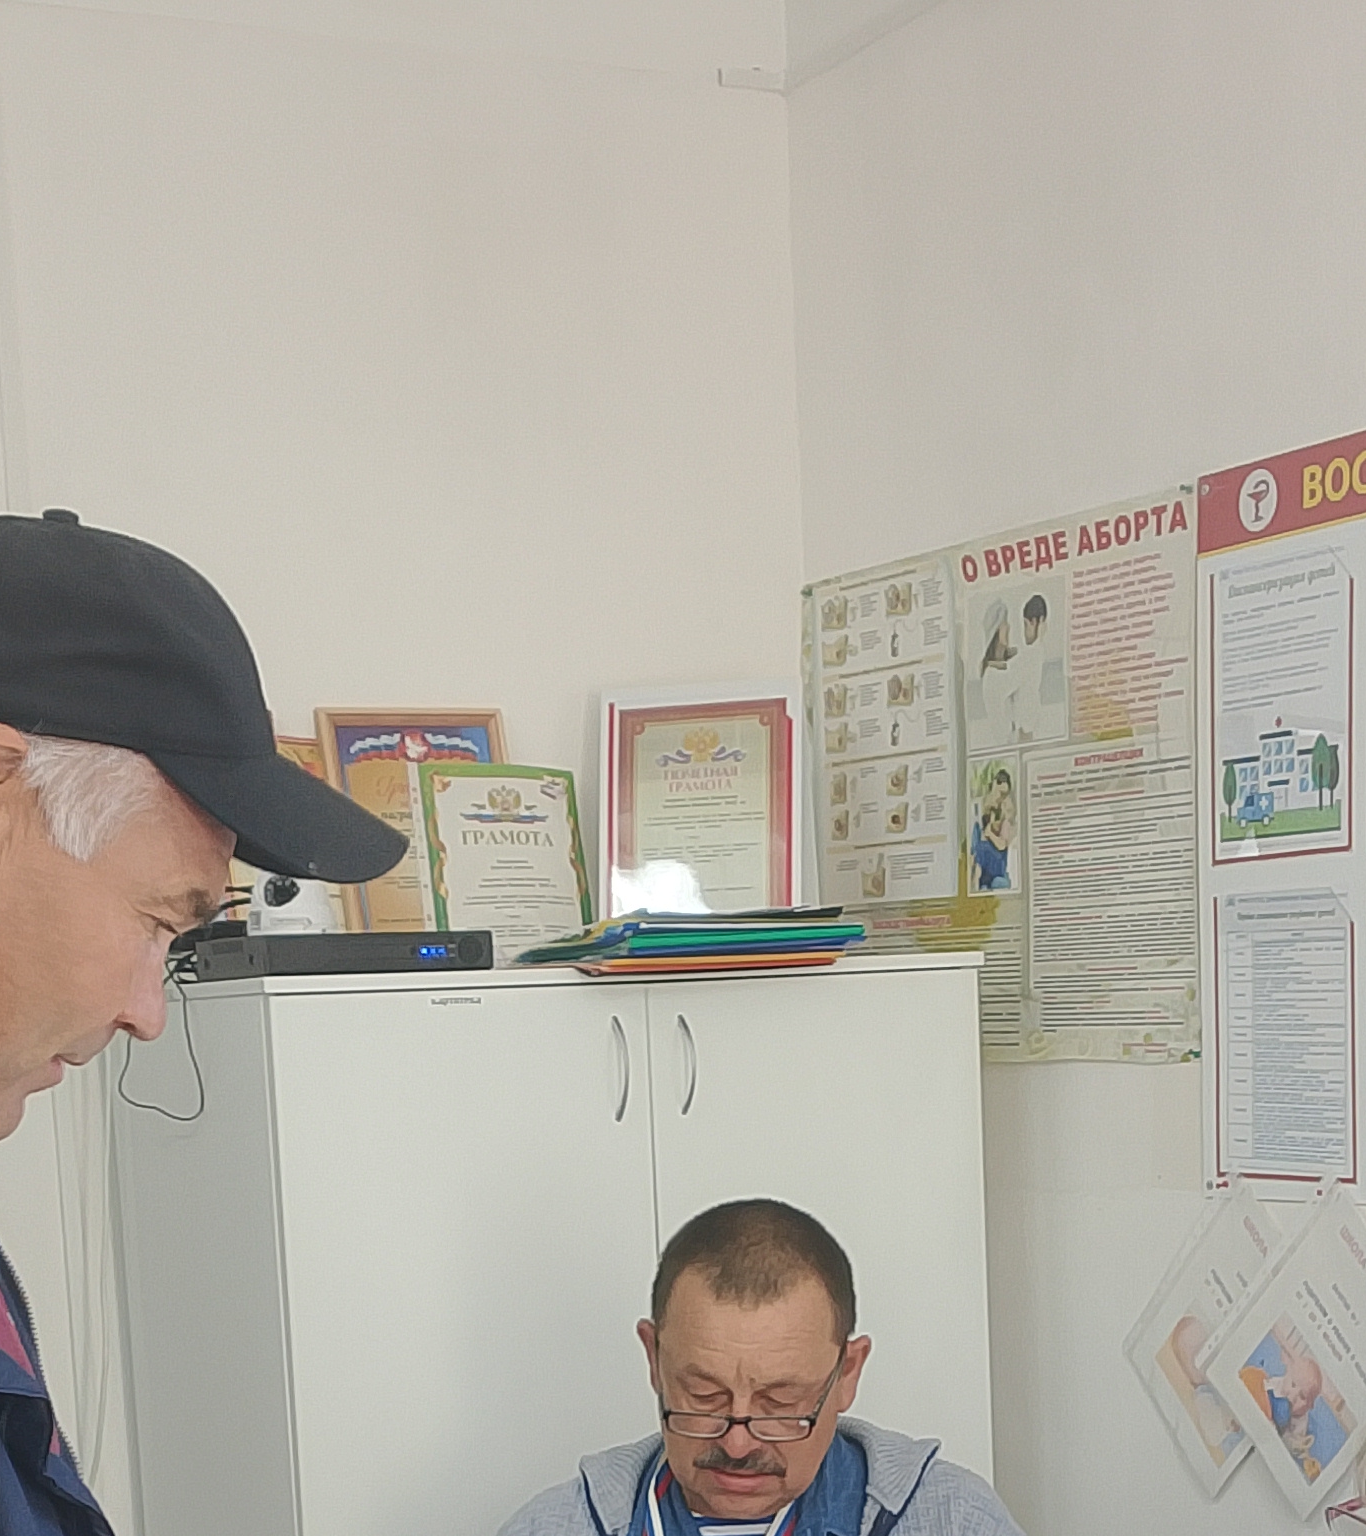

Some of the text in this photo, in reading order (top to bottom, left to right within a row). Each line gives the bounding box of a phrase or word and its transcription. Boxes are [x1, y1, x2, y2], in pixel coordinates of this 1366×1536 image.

[960, 500, 1189, 583] О ВРЕДЕ АБОРТА
[461, 829, 554, 848] ГРАМОТА
